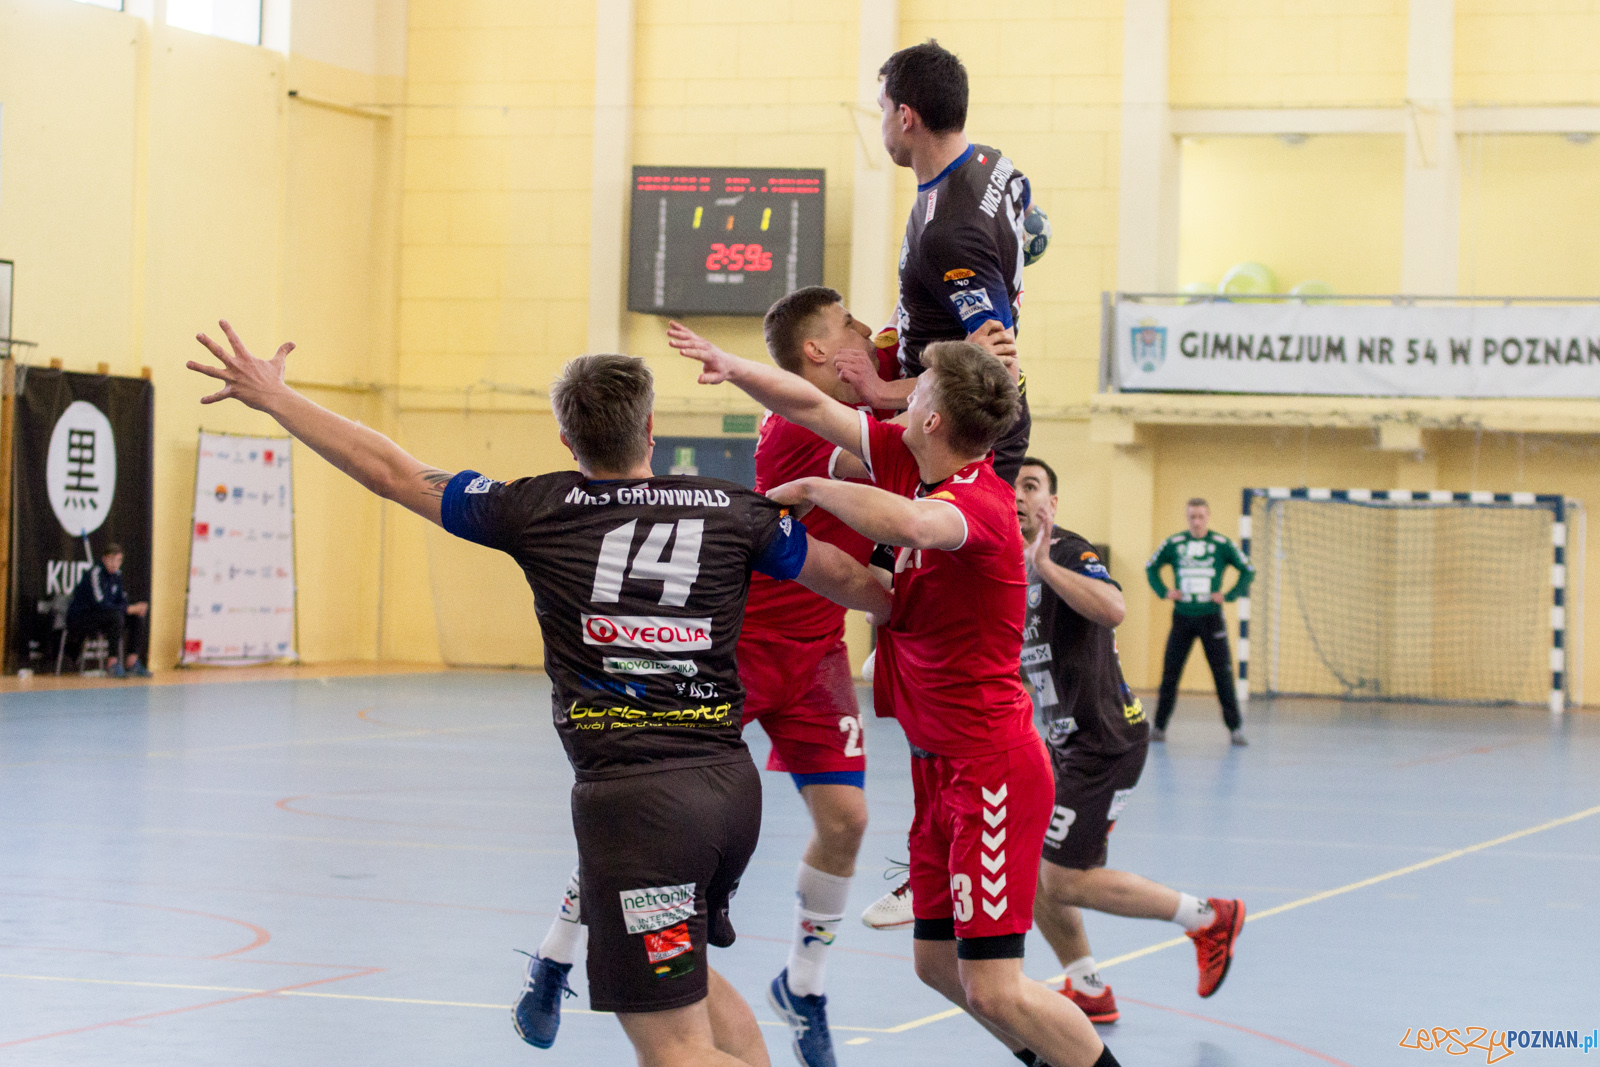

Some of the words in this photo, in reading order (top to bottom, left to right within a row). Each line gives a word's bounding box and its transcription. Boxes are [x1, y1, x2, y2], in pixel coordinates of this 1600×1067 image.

[1180, 331, 1347, 364] GIMNAZJUM
[1357, 336, 1394, 365] NR
[1406, 338, 1438, 365] 54
[1450, 337, 1471, 365] W
[617, 487, 731, 507] GRUNWALD
[590, 517, 705, 608] 14
[621, 625, 709, 643] VEOLIA
[839, 714, 863, 757] 2
[950, 873, 974, 922] 3
